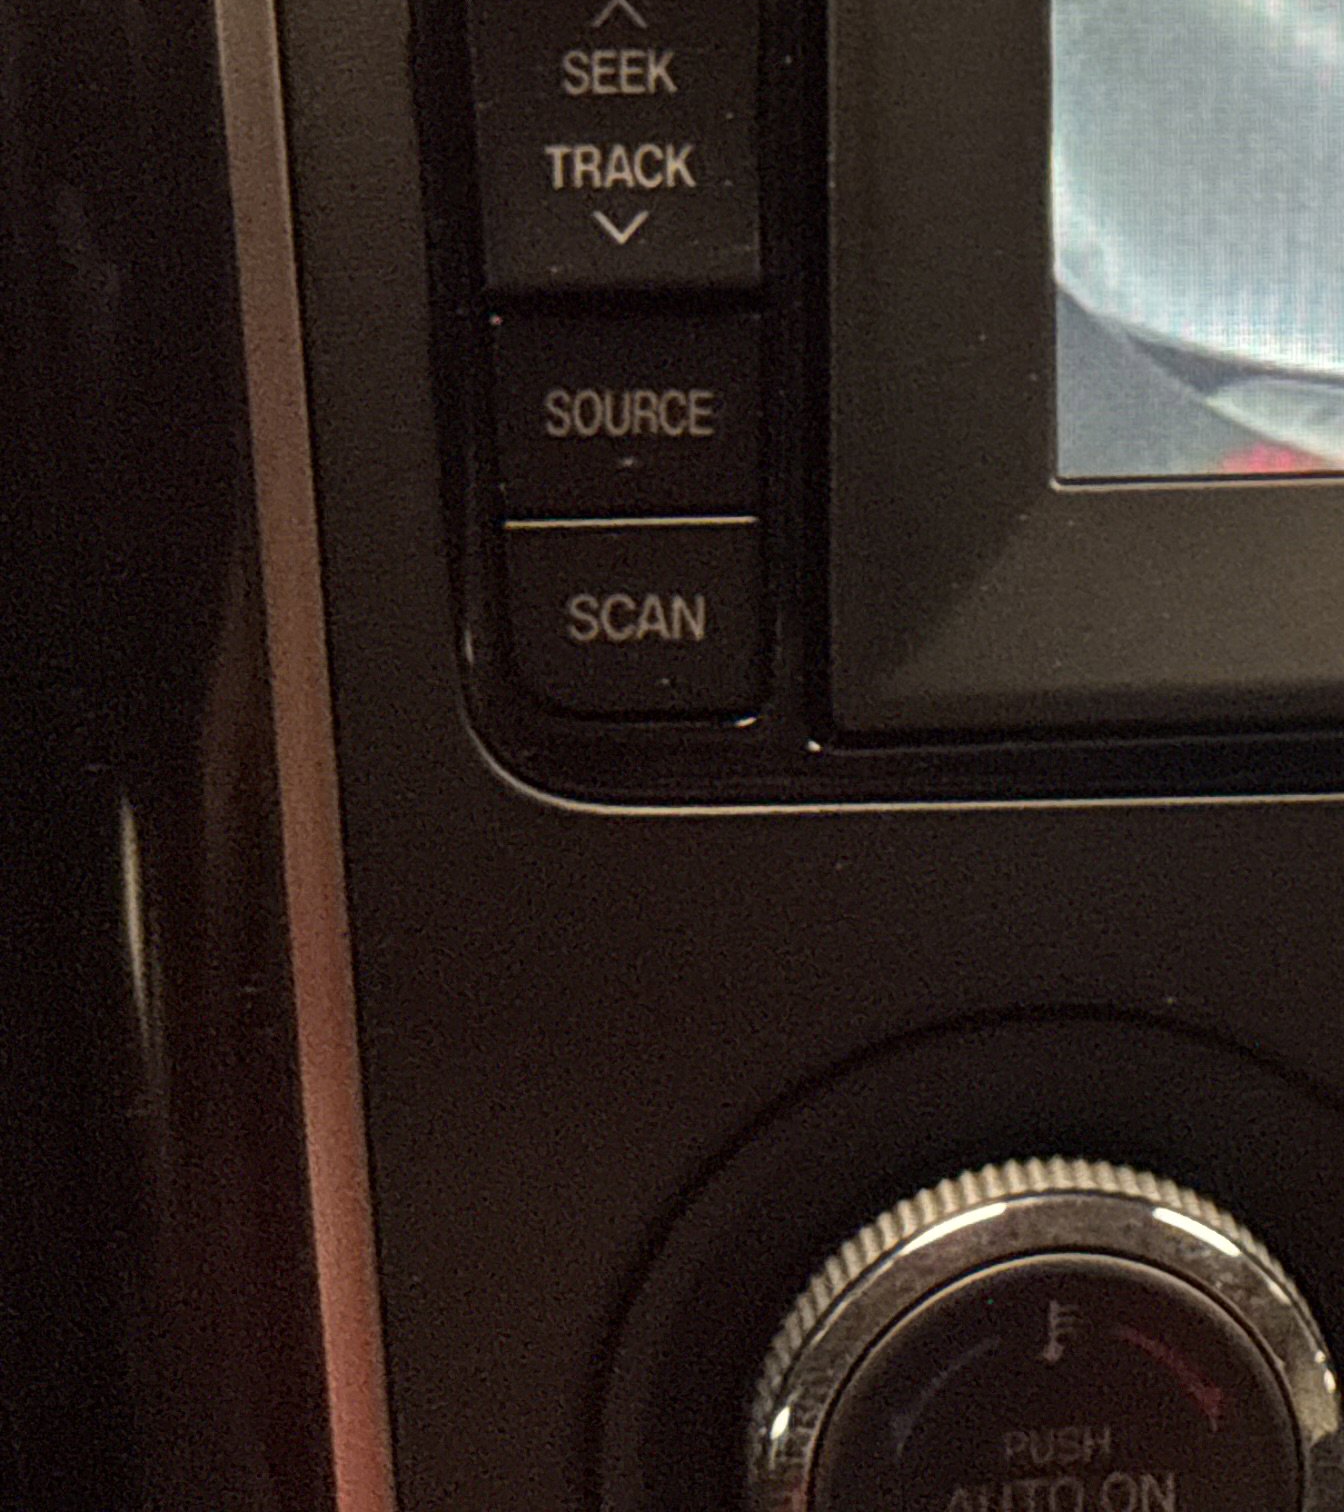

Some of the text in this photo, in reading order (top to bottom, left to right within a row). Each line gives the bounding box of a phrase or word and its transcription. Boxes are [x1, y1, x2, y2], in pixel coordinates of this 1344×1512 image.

[561, 48, 677, 95] SEEK
[544, 143, 696, 190] TRACK
[544, 388, 715, 439] SOURCE
[566, 593, 706, 643] SCAN
[1004, 1426, 1112, 1464] PUSH
[1102, 1471, 1176, 1512] ON
